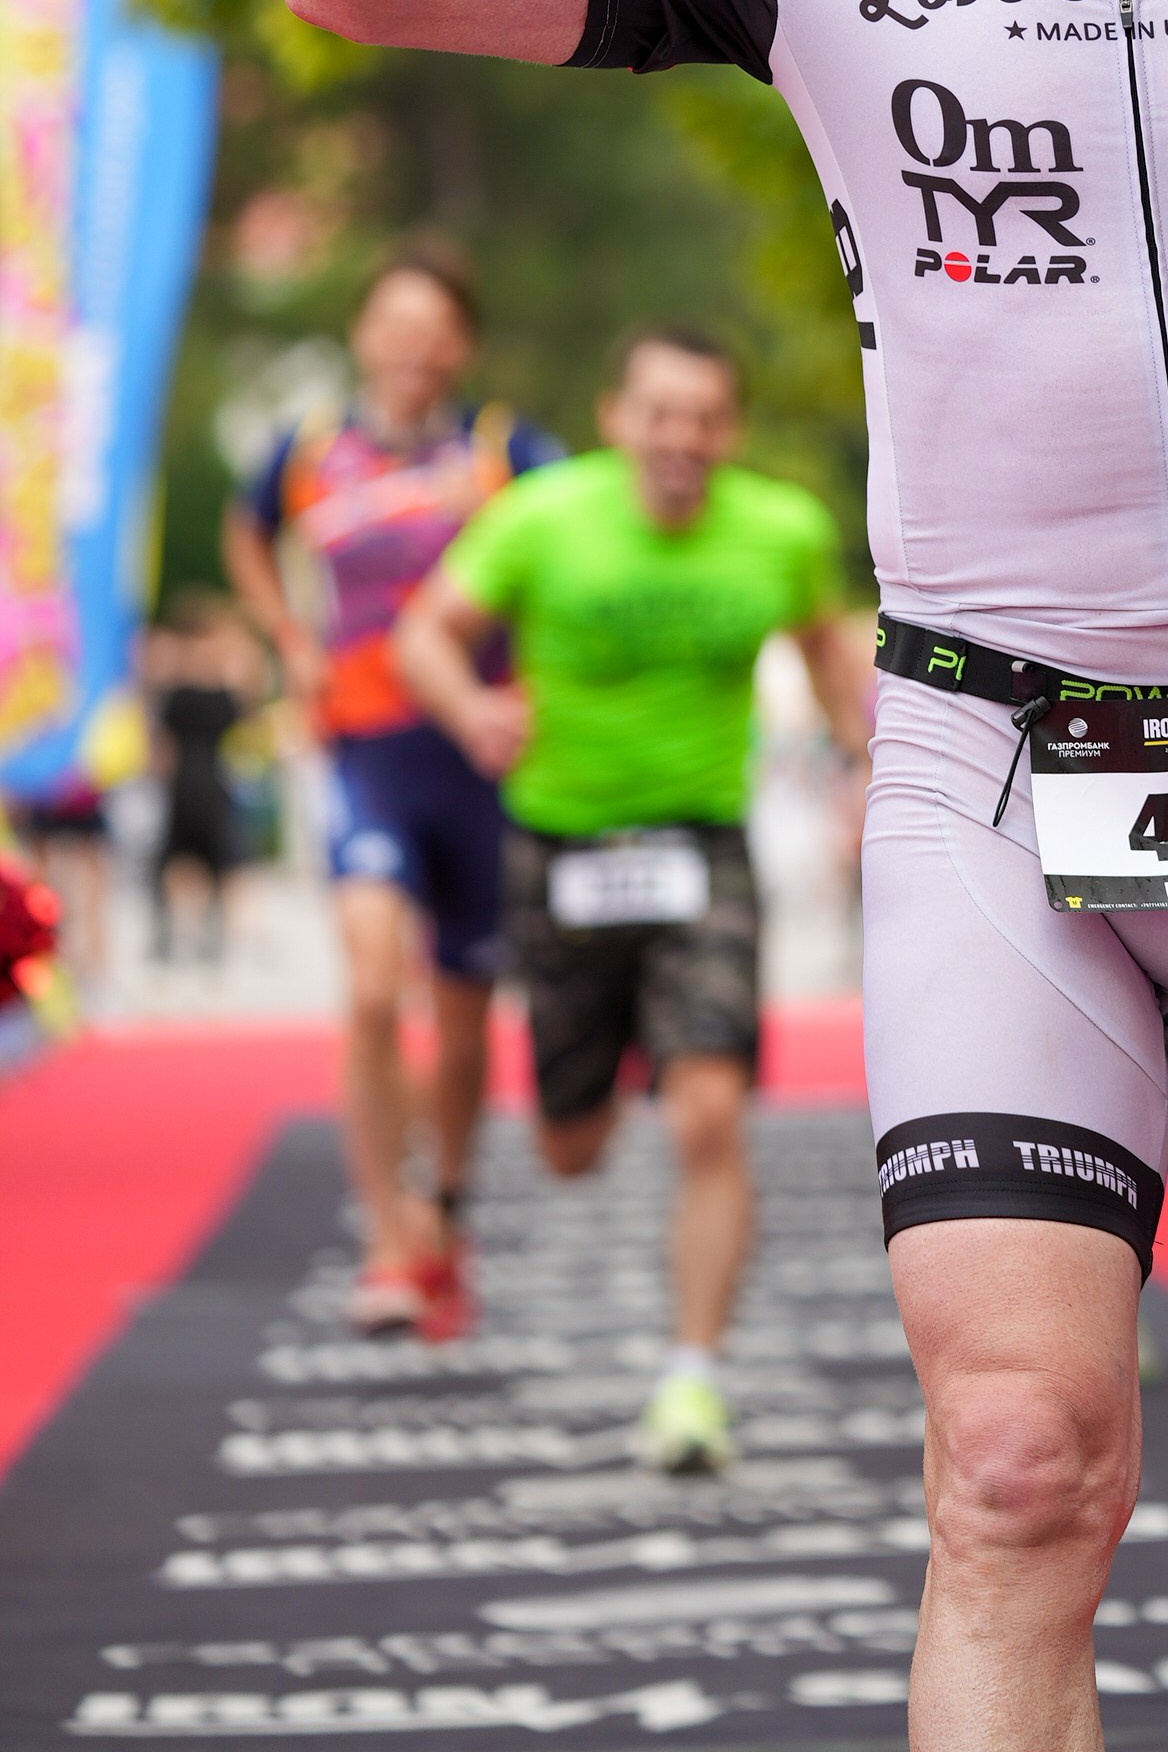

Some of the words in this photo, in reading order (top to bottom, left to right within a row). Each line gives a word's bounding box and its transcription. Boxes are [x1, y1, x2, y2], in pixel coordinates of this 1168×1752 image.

[1036, 22, 1118, 41] MADE
[891, 79, 1084, 173] Om
[1047, 742, 1110, 751] ГАЗПРОМБАНК
[1059, 750, 1101, 758] ПРЕМИУМ
[1012, 1140, 1139, 1210] TRIUMPH
